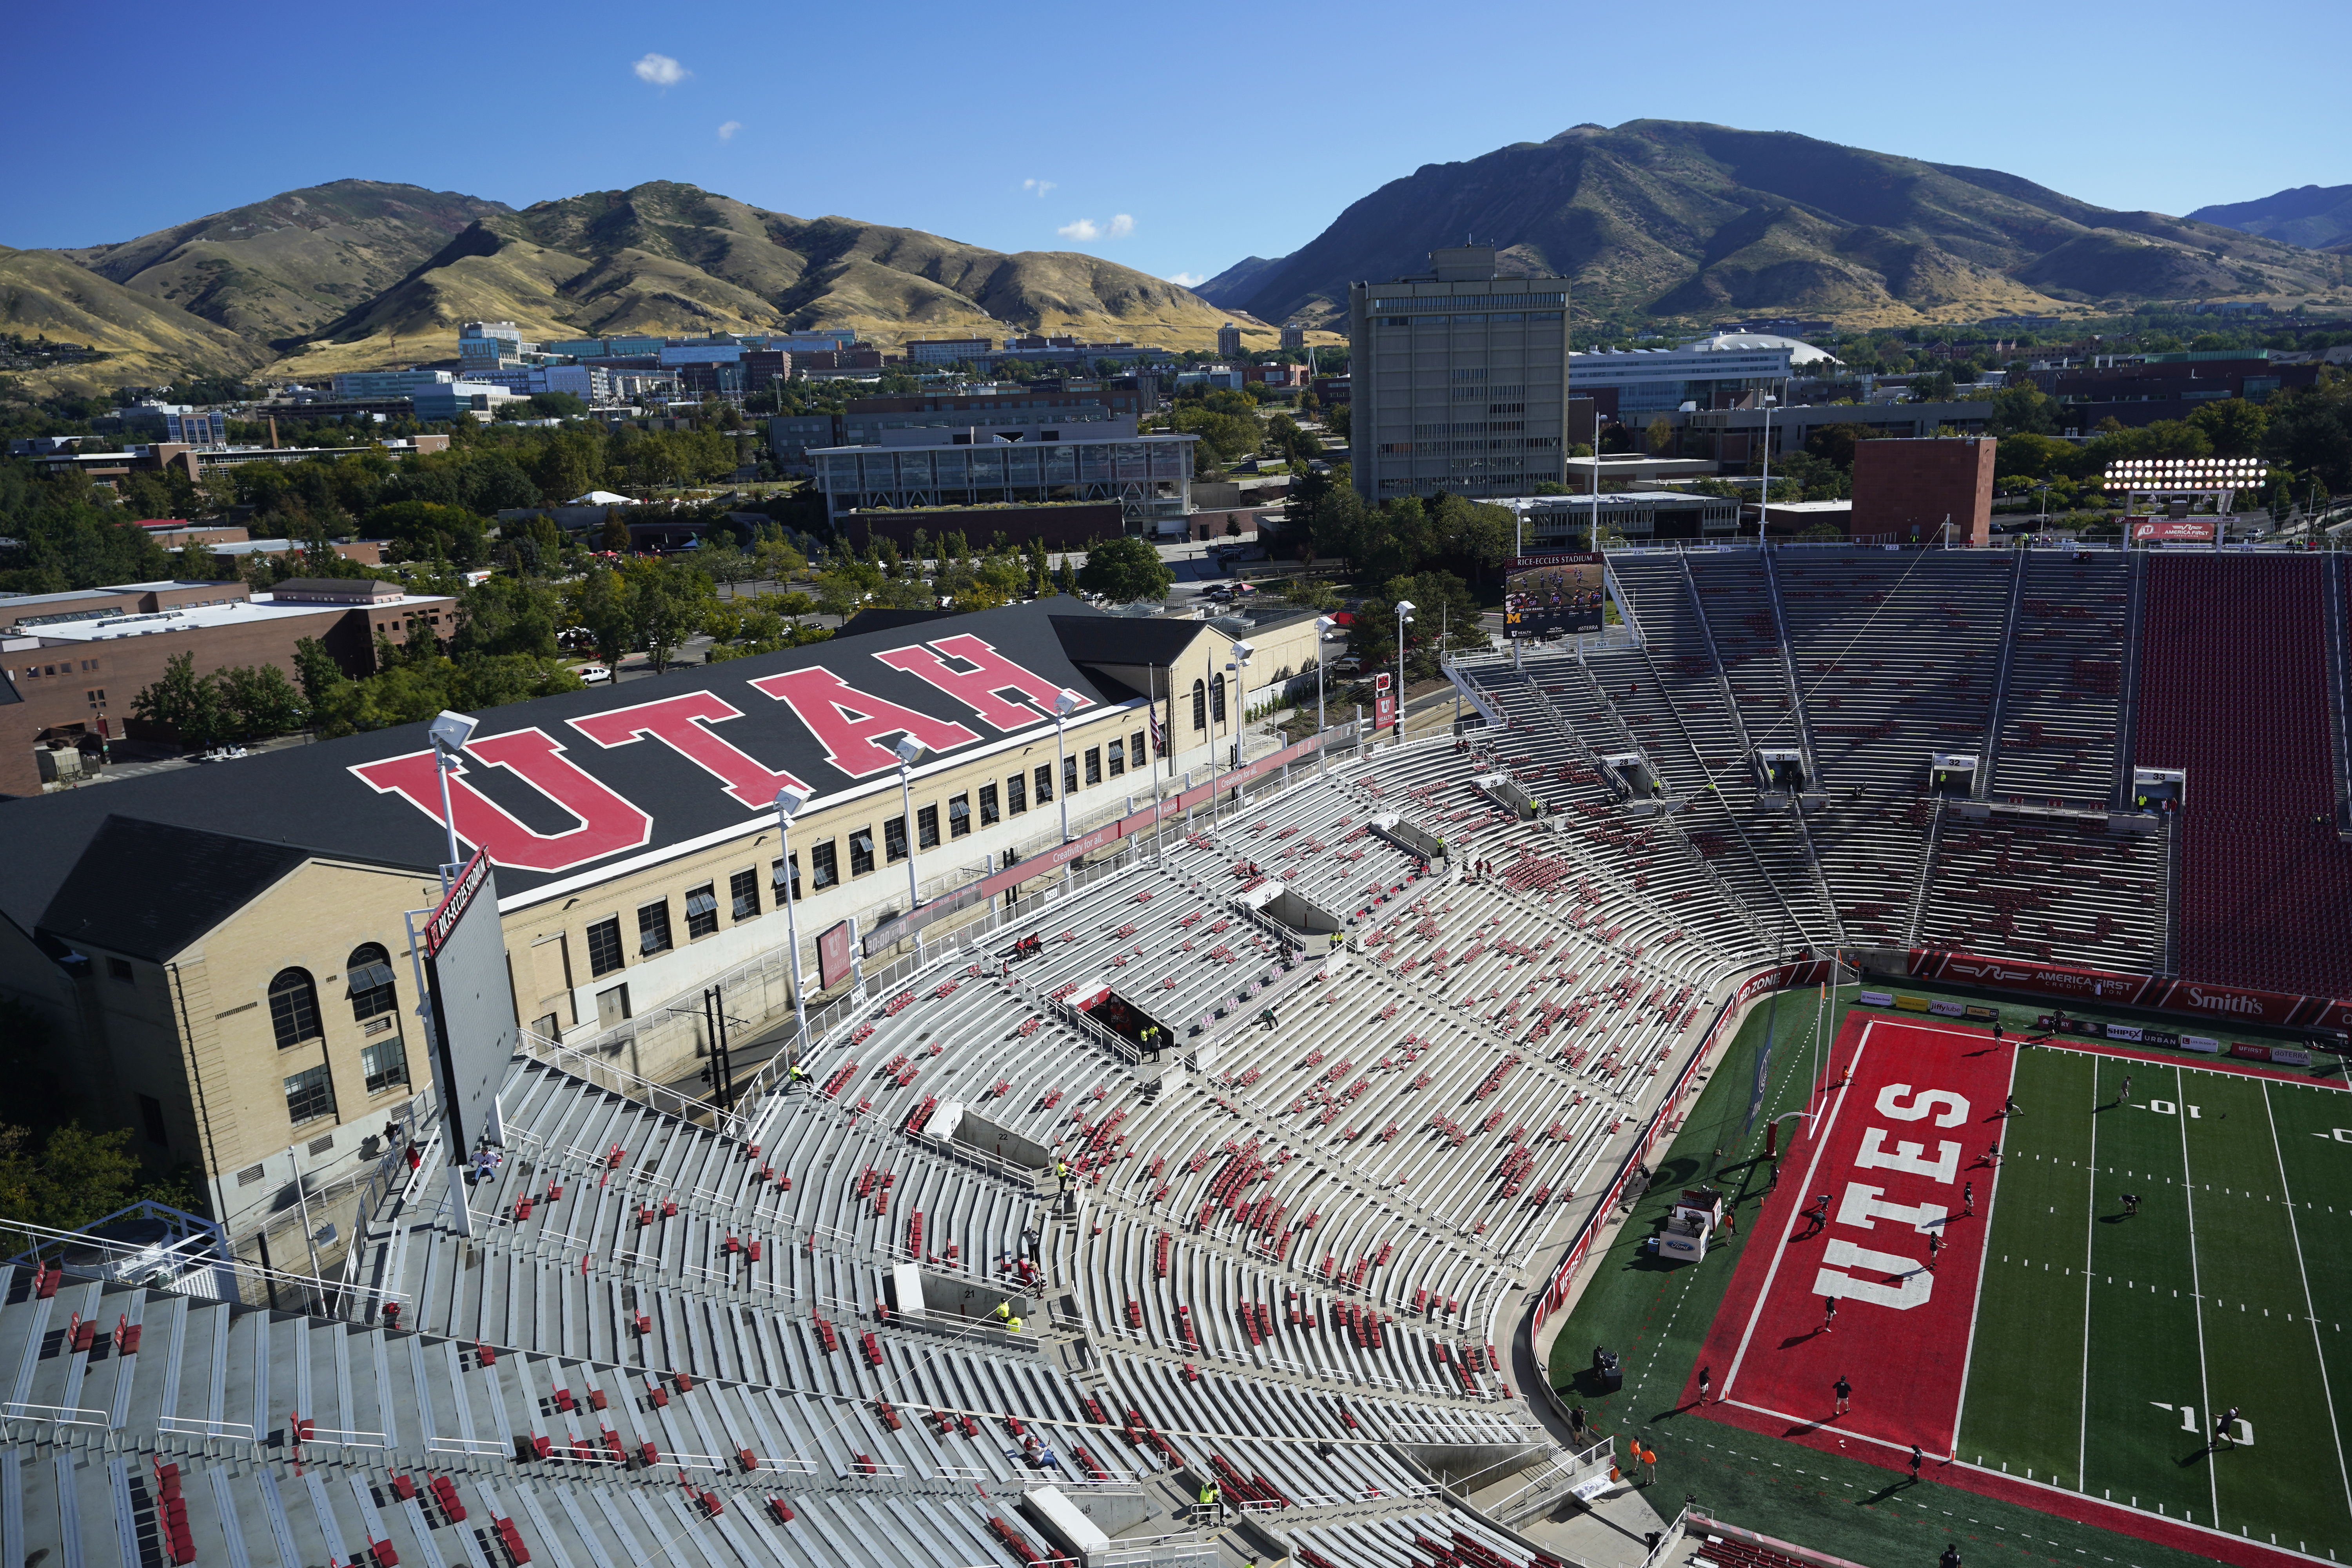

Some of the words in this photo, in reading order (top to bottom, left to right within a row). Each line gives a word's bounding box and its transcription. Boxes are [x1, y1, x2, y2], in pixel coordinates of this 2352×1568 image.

[1517, 557, 1559, 566] RICE-ECCLES
[1561, 554, 1592, 563] STADIUM
[1506, 613, 1521, 624] M
[1379, 675, 1388, 688] 25
[1378, 714, 1393, 722] HEALTH
[347, 633, 1098, 872] UTAH
[1221, 774, 1242, 788] Creativity
[1163, 802, 1178, 814] Adobe
[1388, 819, 1393, 828] 25
[1053, 842, 1083, 863] Creativity
[1083, 838, 1093, 851] for
[1094, 831, 1103, 846] all.
[439, 883, 468, 937] RICE-ECCLES
[465, 856, 486, 896] STADIUM
[1047, 890, 1056, 899] N23
[1265, 892, 1271, 902] 24
[914, 909, 924, 917] DOWN
[866, 931, 889, 954] 90:00
[827, 956, 846, 975] HEALTH
[1750, 972, 1781, 993] ZONE
[2036, 971, 2093, 986] AMERICA
[2045, 981, 2083, 990] CREDIT
[2089, 987, 2122, 996] UION
[854, 990, 863, 1002] N22
[2188, 987, 2263, 1014] Smith's
[1931, 1003, 1945, 1012] jiffy
[1946, 1004, 1960, 1013] lube
[2107, 1028, 2142, 1039] SHIPEX
[2145, 1035, 2176, 1045] URBAN
[2239, 1045, 2263, 1054] UFIRST
[2151, 1099, 2201, 1118] 10
[951, 1117, 956, 1132] 21
[1812, 1083, 1971, 1310] UTES
[1600, 1197, 1616, 1229] RED
[1671, 1241, 1689, 1250] Ford
[1560, 1247, 1583, 1294] UFIRST
[965, 1290, 975, 1298] 21
